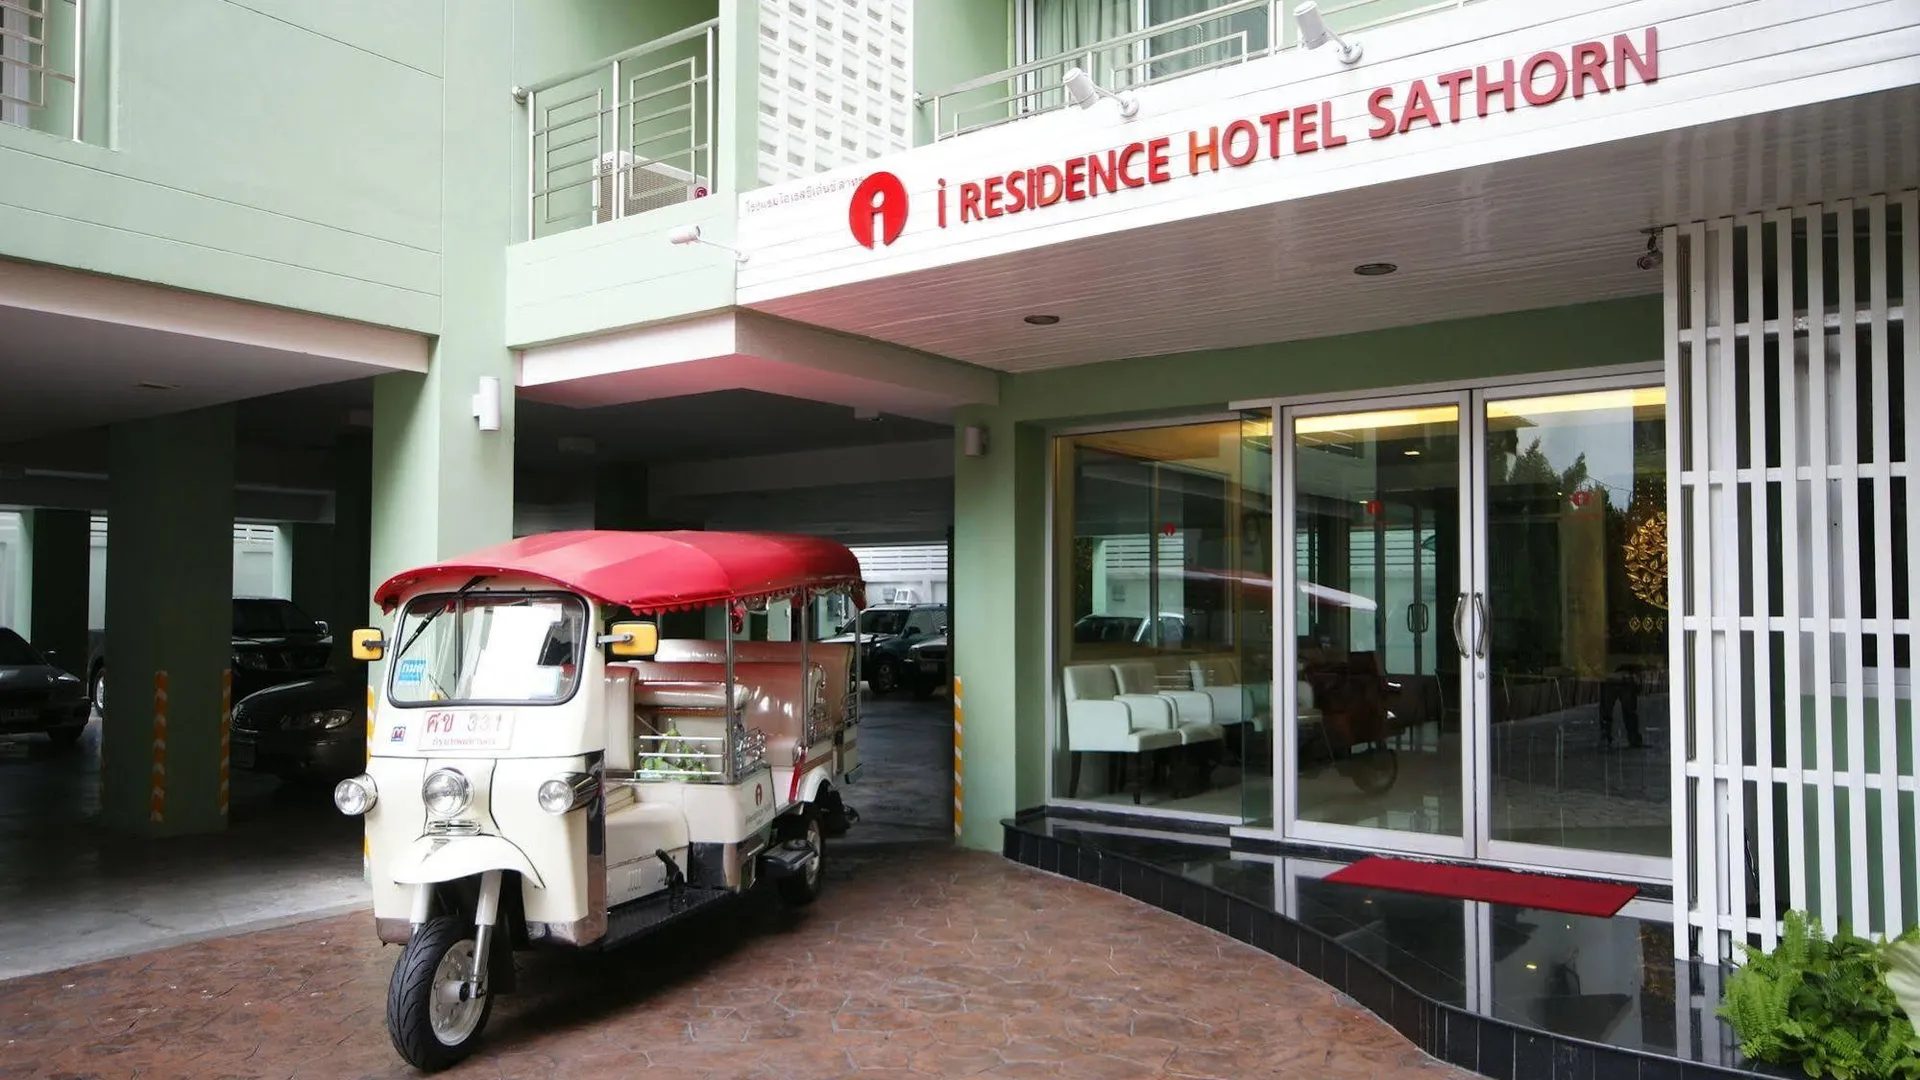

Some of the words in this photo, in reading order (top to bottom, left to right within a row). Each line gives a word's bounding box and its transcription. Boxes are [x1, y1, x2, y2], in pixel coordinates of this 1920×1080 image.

[937, 178, 948, 229] i
[959, 137, 1171, 223] RESIDENCE
[1188, 101, 1348, 175] HOTEL
[1367, 28, 1658, 140] SATHORN
